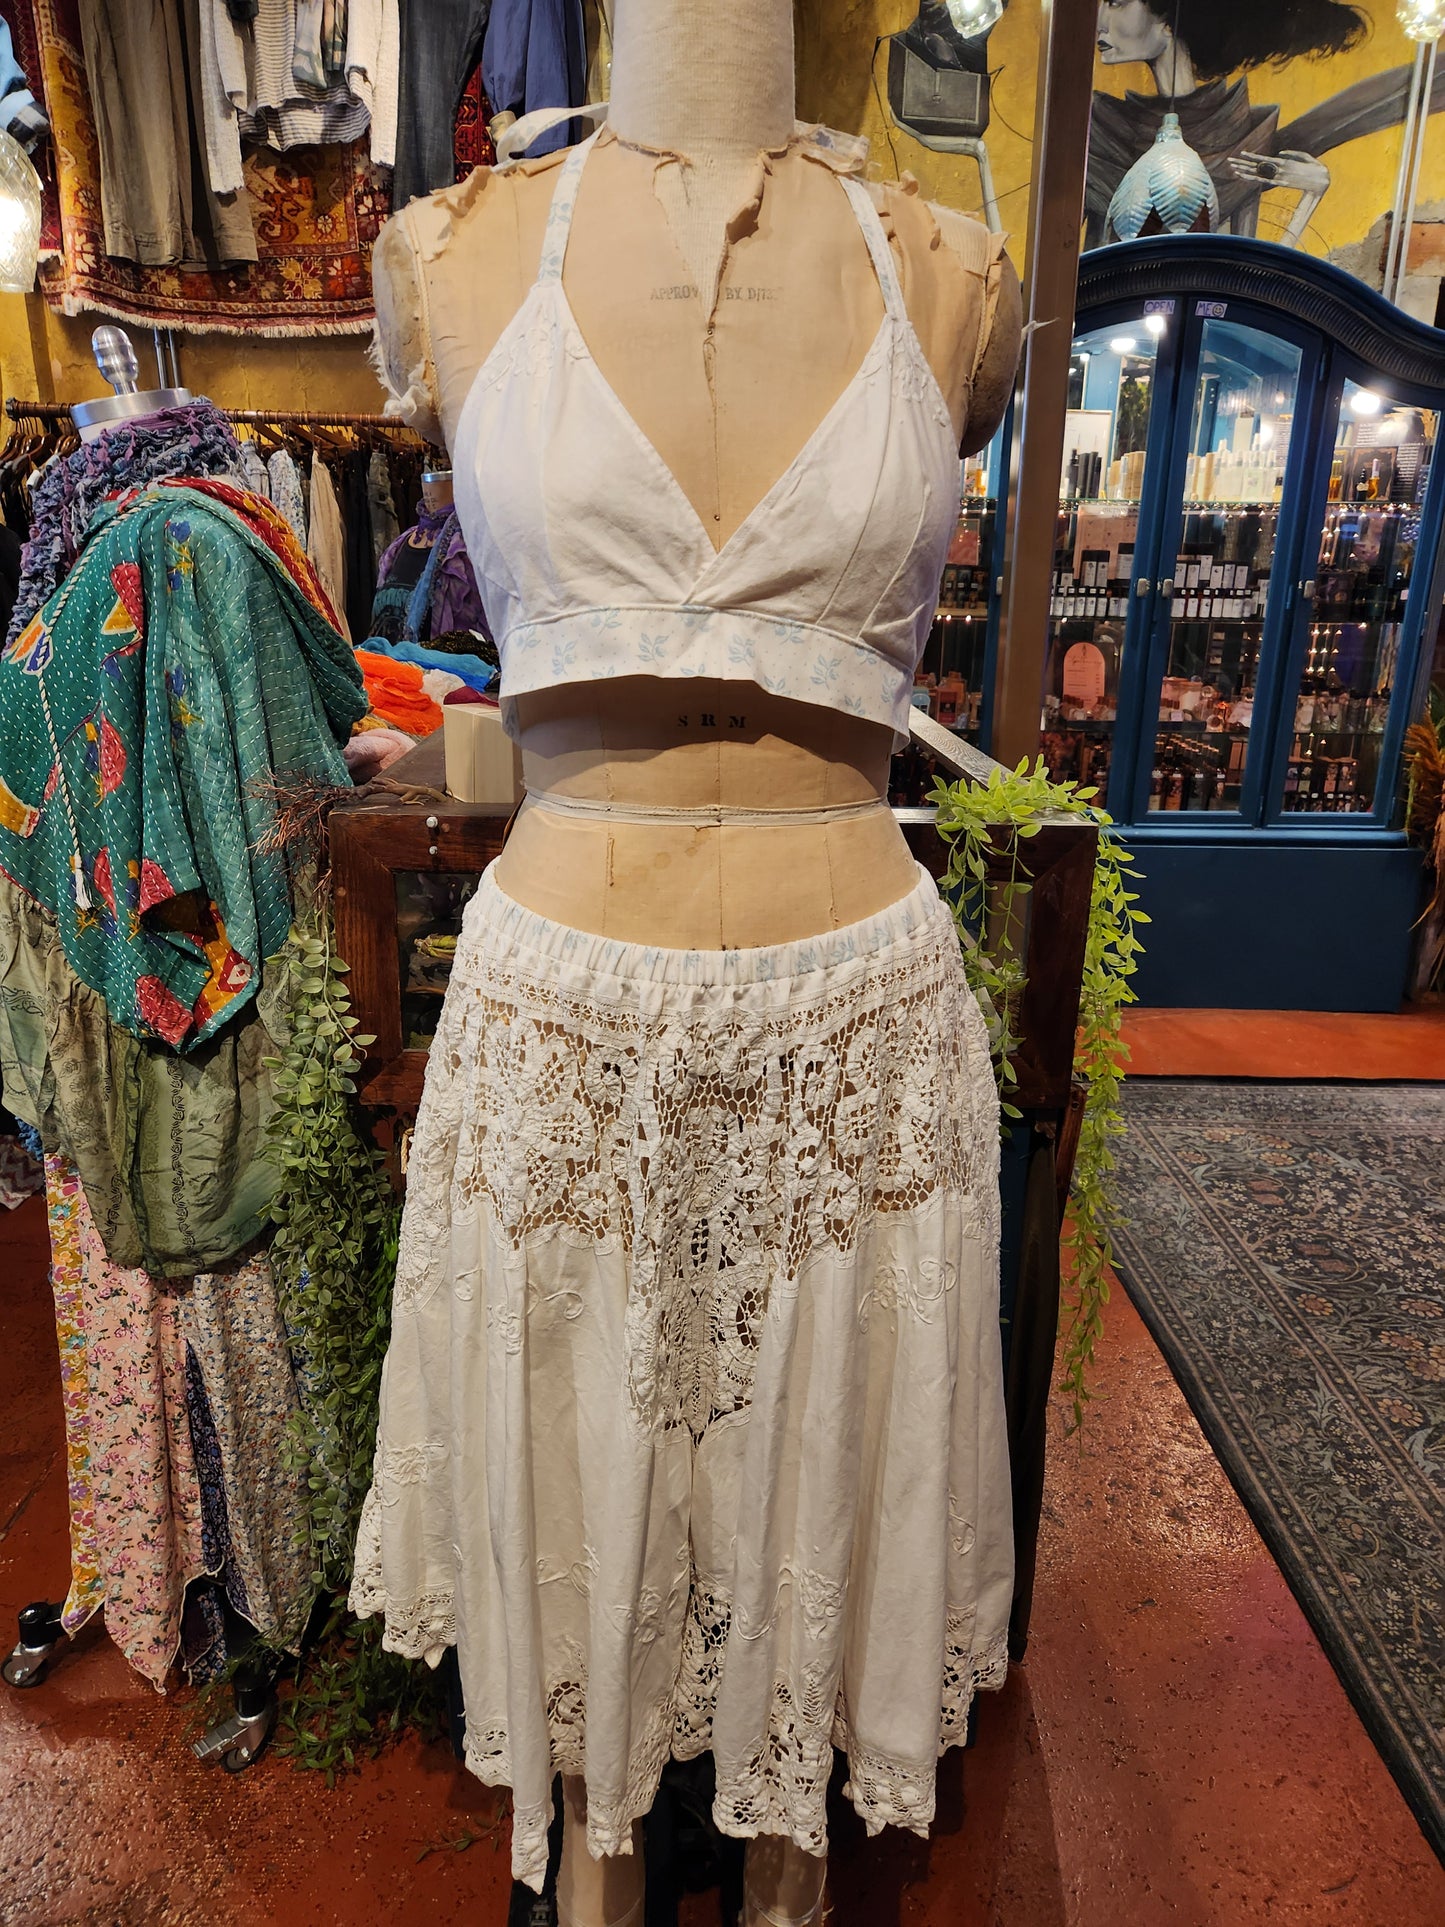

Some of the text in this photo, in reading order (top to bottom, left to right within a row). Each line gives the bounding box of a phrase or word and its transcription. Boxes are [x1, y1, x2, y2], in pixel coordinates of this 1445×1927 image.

[725, 286, 742, 301] BY
[1144, 300, 1212, 316] OPEN ME
